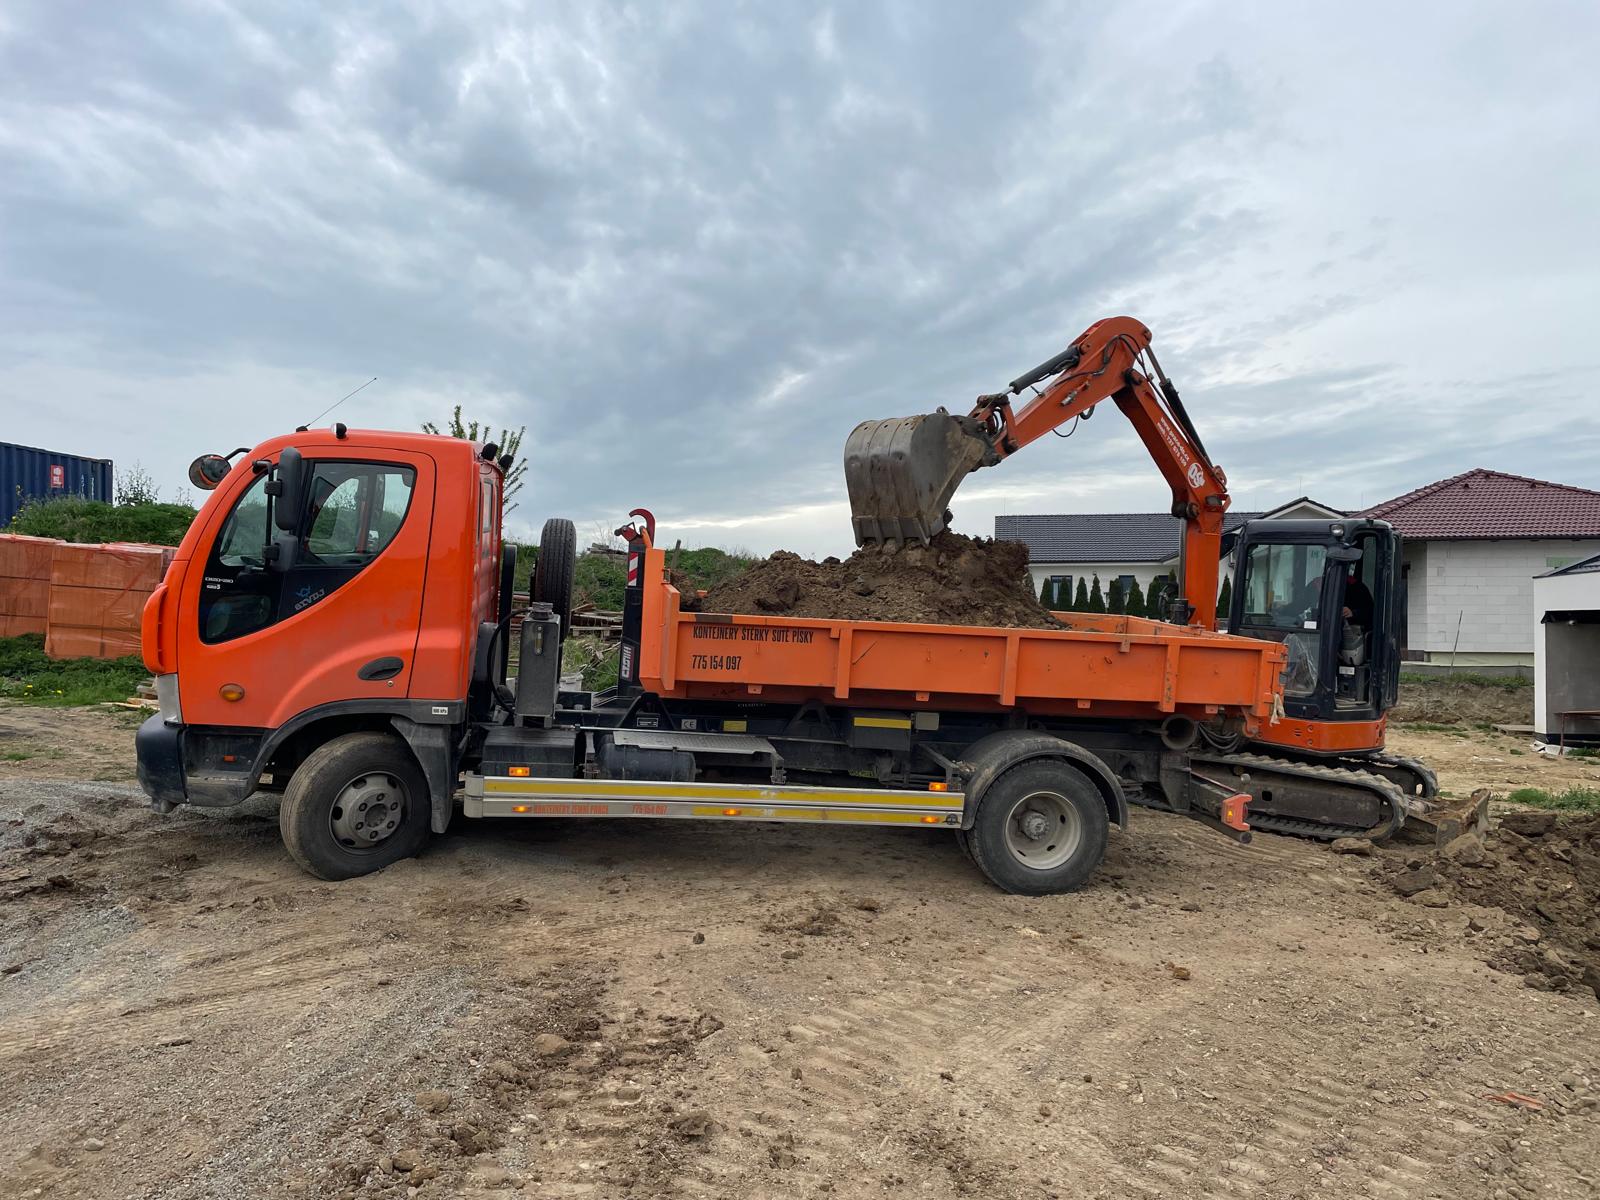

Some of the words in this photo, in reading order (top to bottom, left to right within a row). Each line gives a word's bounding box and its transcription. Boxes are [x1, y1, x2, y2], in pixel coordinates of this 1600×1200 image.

[693, 624, 738, 641] KONTEJNERY
[692, 654, 707, 670] 775
[709, 655, 723, 670] 154
[725, 655, 741, 671] 097
